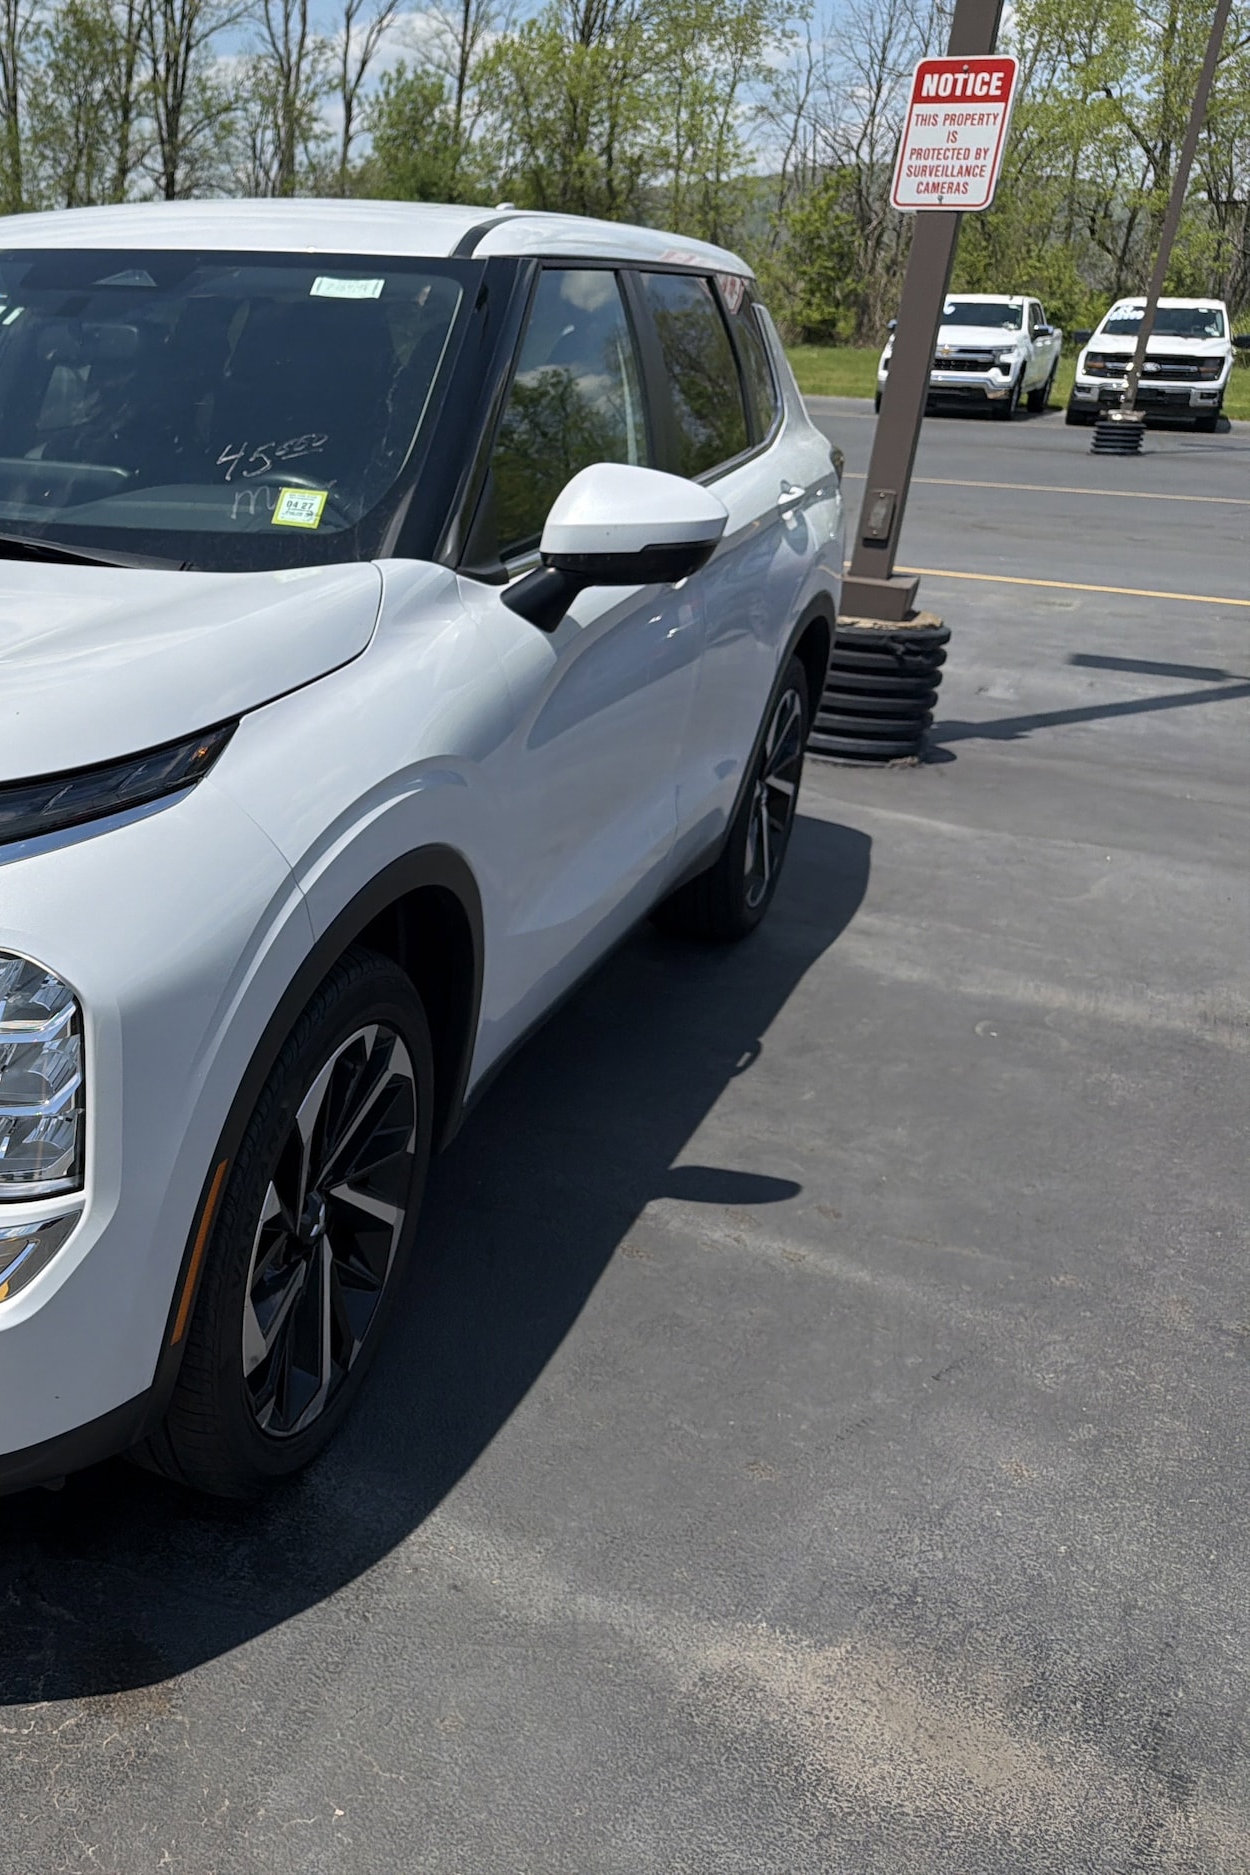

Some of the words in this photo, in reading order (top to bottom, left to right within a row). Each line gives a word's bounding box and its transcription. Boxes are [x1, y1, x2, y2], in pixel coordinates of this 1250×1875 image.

[921, 72, 1004, 97] NOTICE
[915, 114, 939, 126] THIS
[943, 113, 999, 126] PROPERTY
[946, 131, 958, 143] IS
[909, 148, 970, 160] PROTECTED
[974, 148, 989, 160] BY
[906, 165, 986, 177] SURVEILLANCE
[916, 182, 969, 194] CAMERAS
[301, 502, 314, 510] 27
